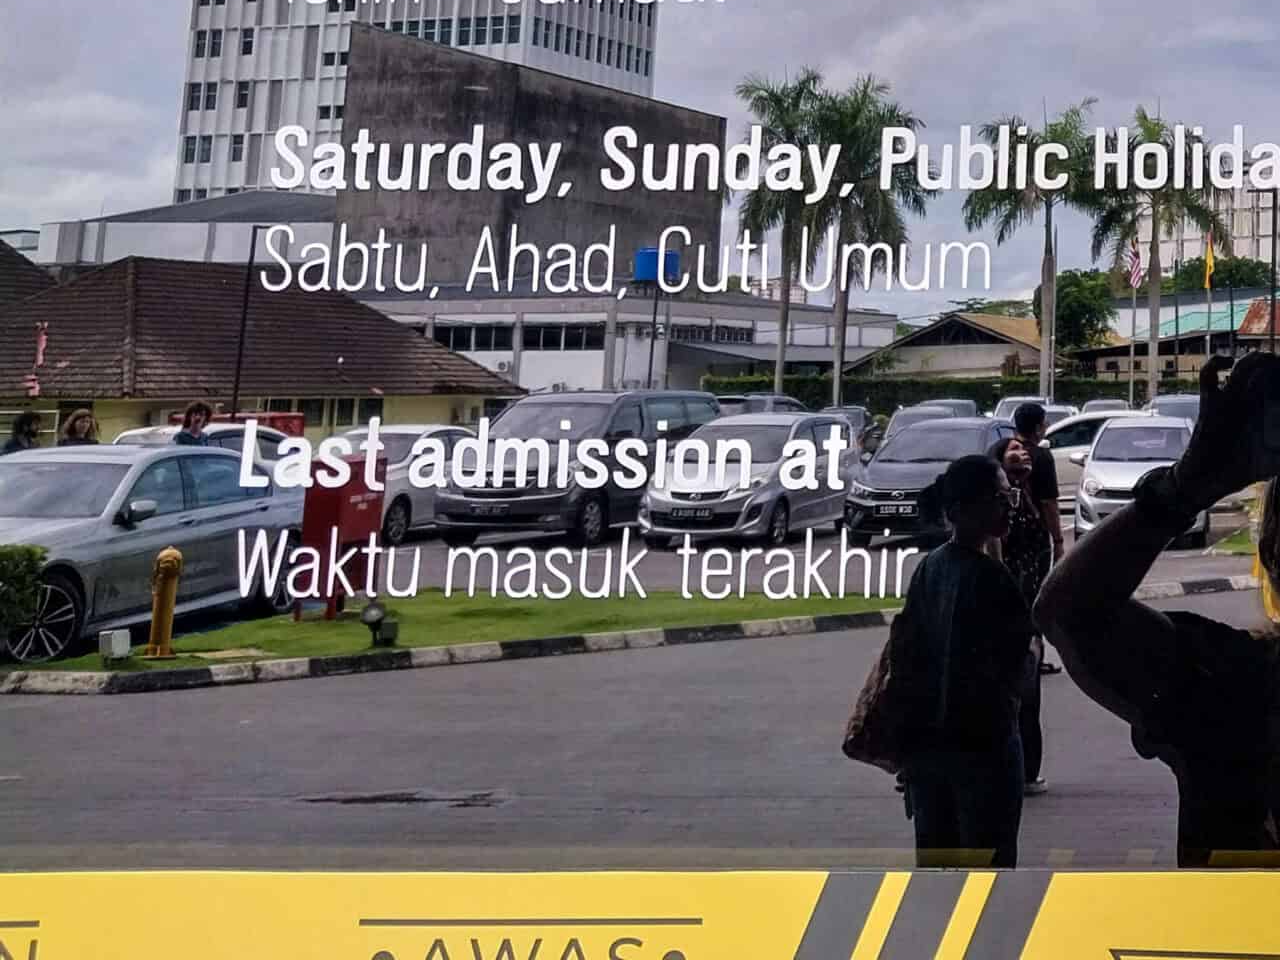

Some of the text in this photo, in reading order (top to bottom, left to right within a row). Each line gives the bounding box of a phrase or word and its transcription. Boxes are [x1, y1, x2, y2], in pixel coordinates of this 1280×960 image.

[269, 124, 573, 205] Saturday,
[599, 124, 855, 204] Sunday,
[878, 124, 1070, 192] Public
[259, 223, 992, 300] Sabtu, Ahad, Cuti Umum
[238, 416, 849, 492] Last admission at
[237, 525, 919, 600] Waktu masuk terakhir
